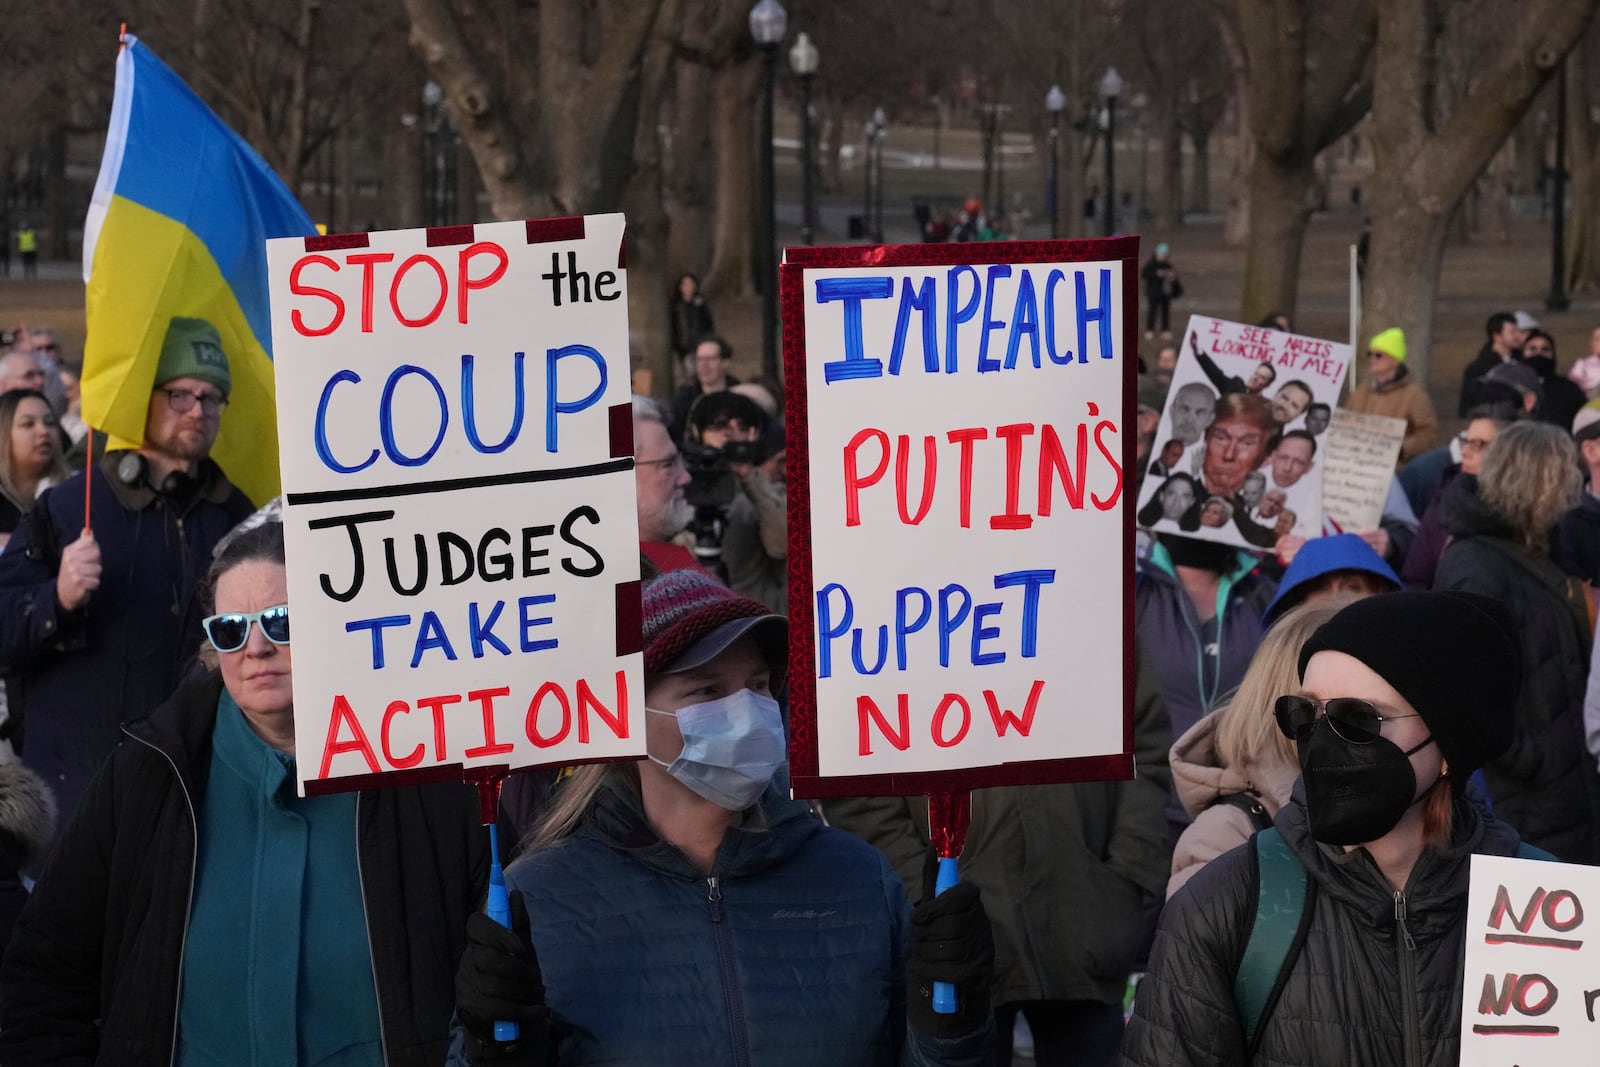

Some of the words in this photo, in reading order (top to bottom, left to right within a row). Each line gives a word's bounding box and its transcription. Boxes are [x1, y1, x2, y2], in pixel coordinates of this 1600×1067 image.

[290, 242, 509, 337] STOP
[541, 251, 622, 306] the
[816, 265, 1113, 384] IMPEACH
[1208, 318, 1224, 335] I
[1239, 326, 1272, 346] SEE
[1284, 336, 1333, 358] NAZIS
[1210, 338, 1276, 364] LOOKING
[1277, 351, 1300, 369] AT
[1301, 357, 1344, 385] ME!
[314, 344, 608, 474] COUP
[844, 402, 1122, 530] PUTIN'S
[308, 504, 606, 602] JUDGES
[346, 594, 558, 669] TAKE
[816, 569, 1056, 679] PUPPET
[318, 670, 629, 780] ACTION
[856, 680, 1045, 756] NOW
[1487, 884, 1584, 934] NO
[1478, 973, 1558, 1016] NO
